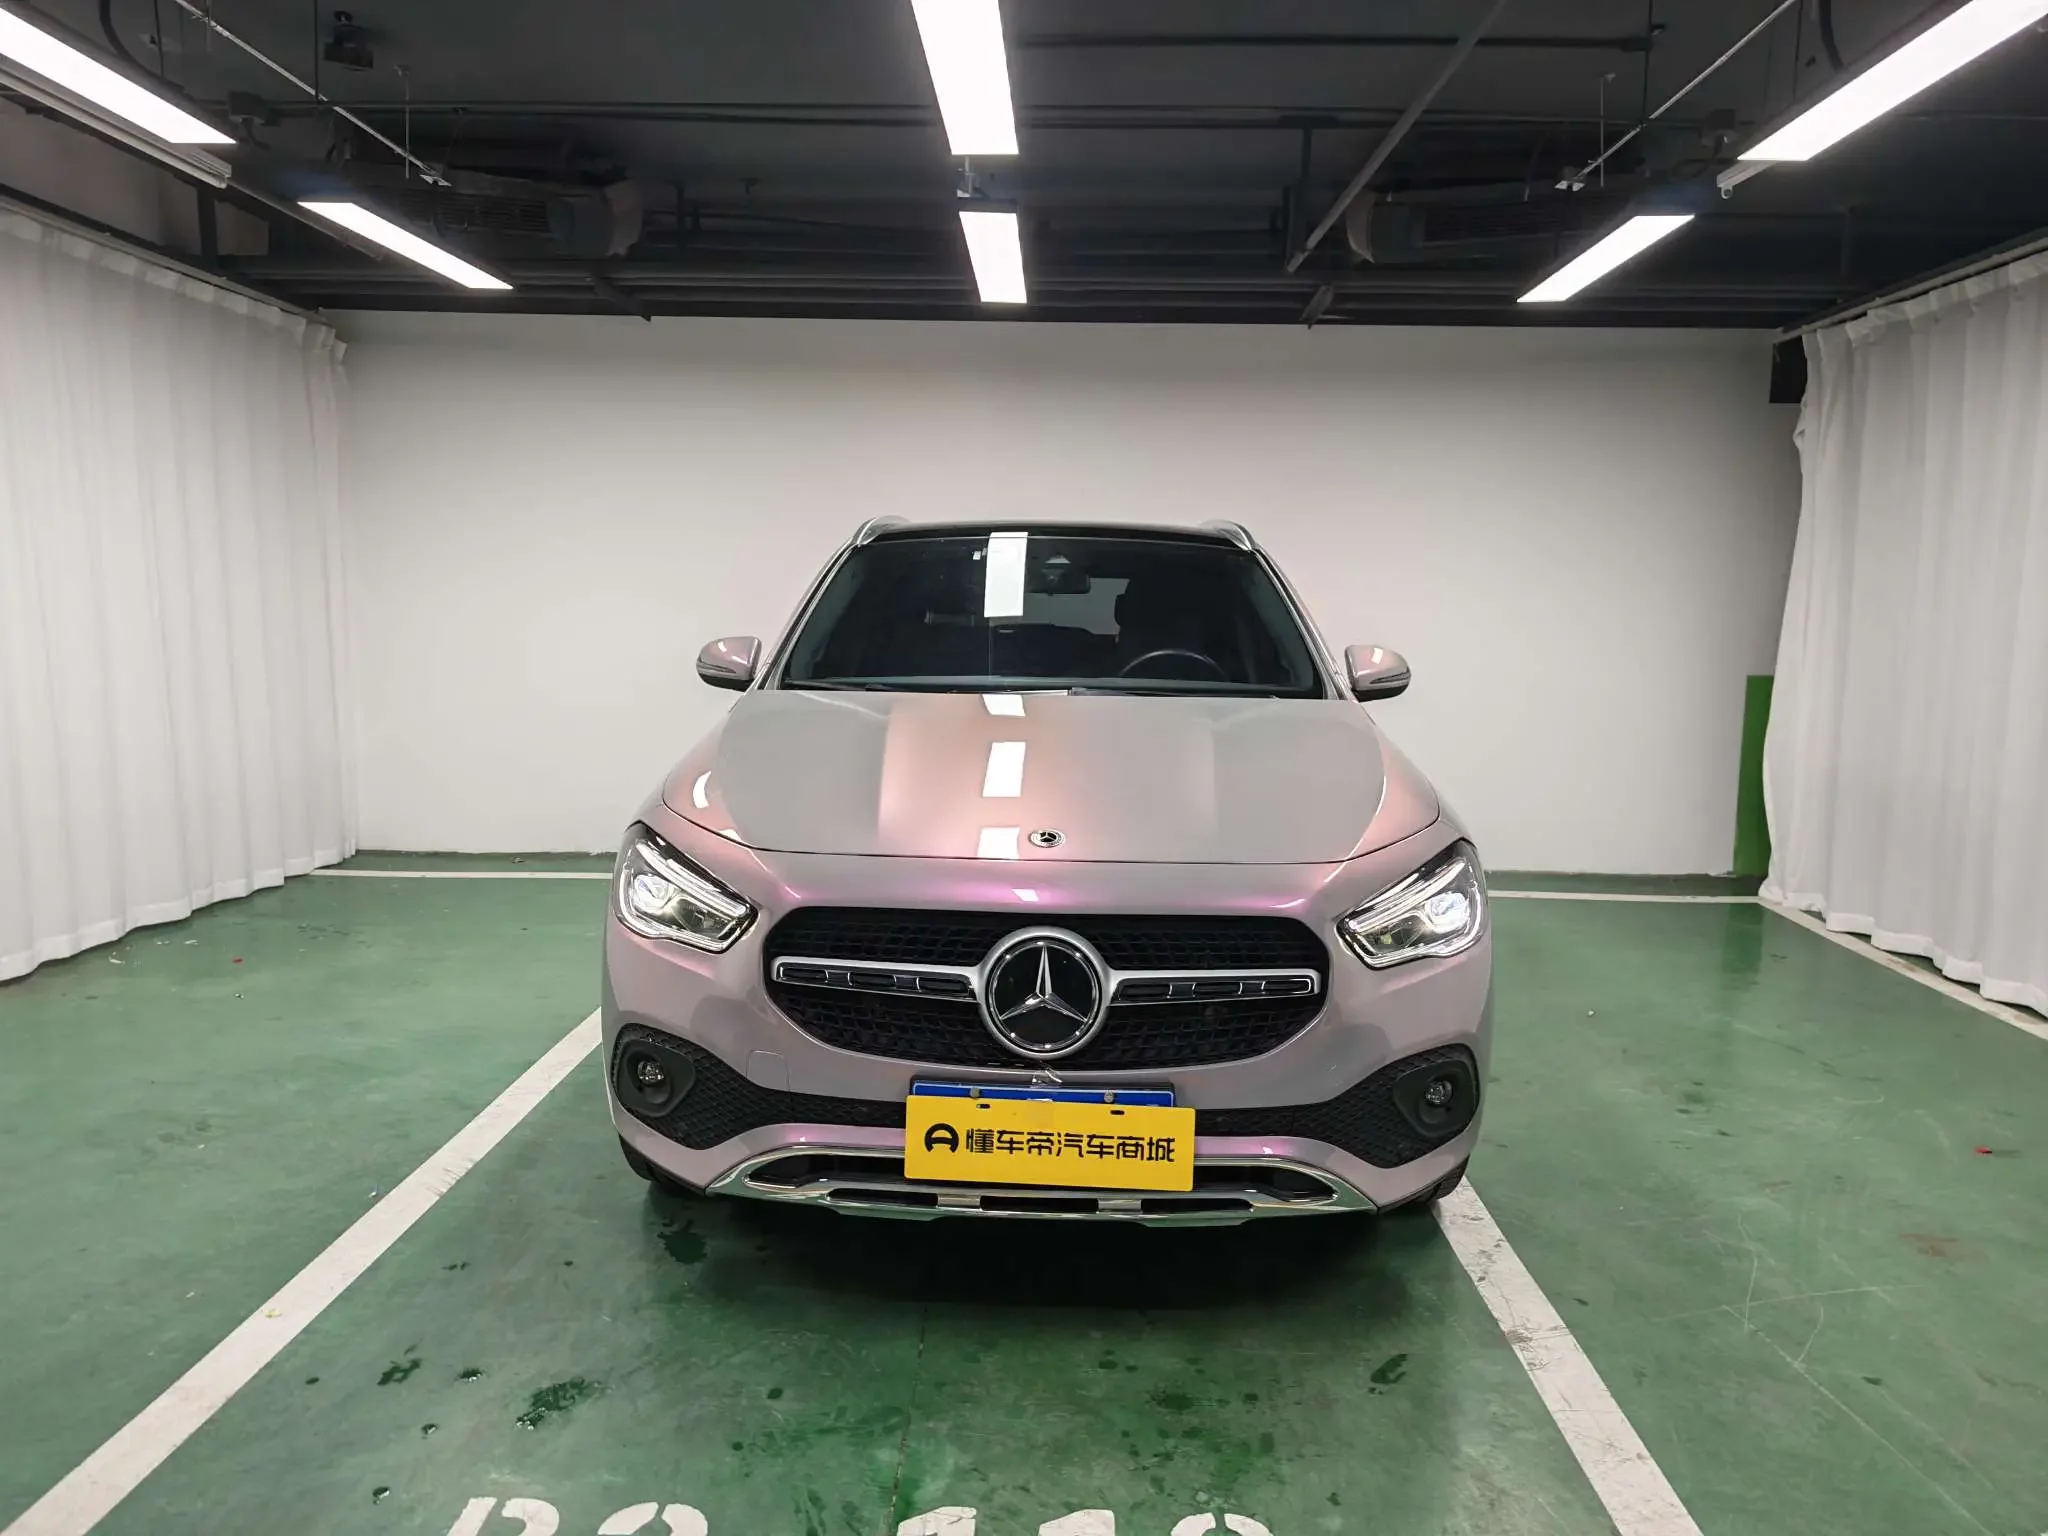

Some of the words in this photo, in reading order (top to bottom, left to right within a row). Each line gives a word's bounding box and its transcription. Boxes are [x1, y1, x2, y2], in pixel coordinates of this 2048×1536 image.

[966, 1128, 1176, 1162] 懂车帝汽车商城
